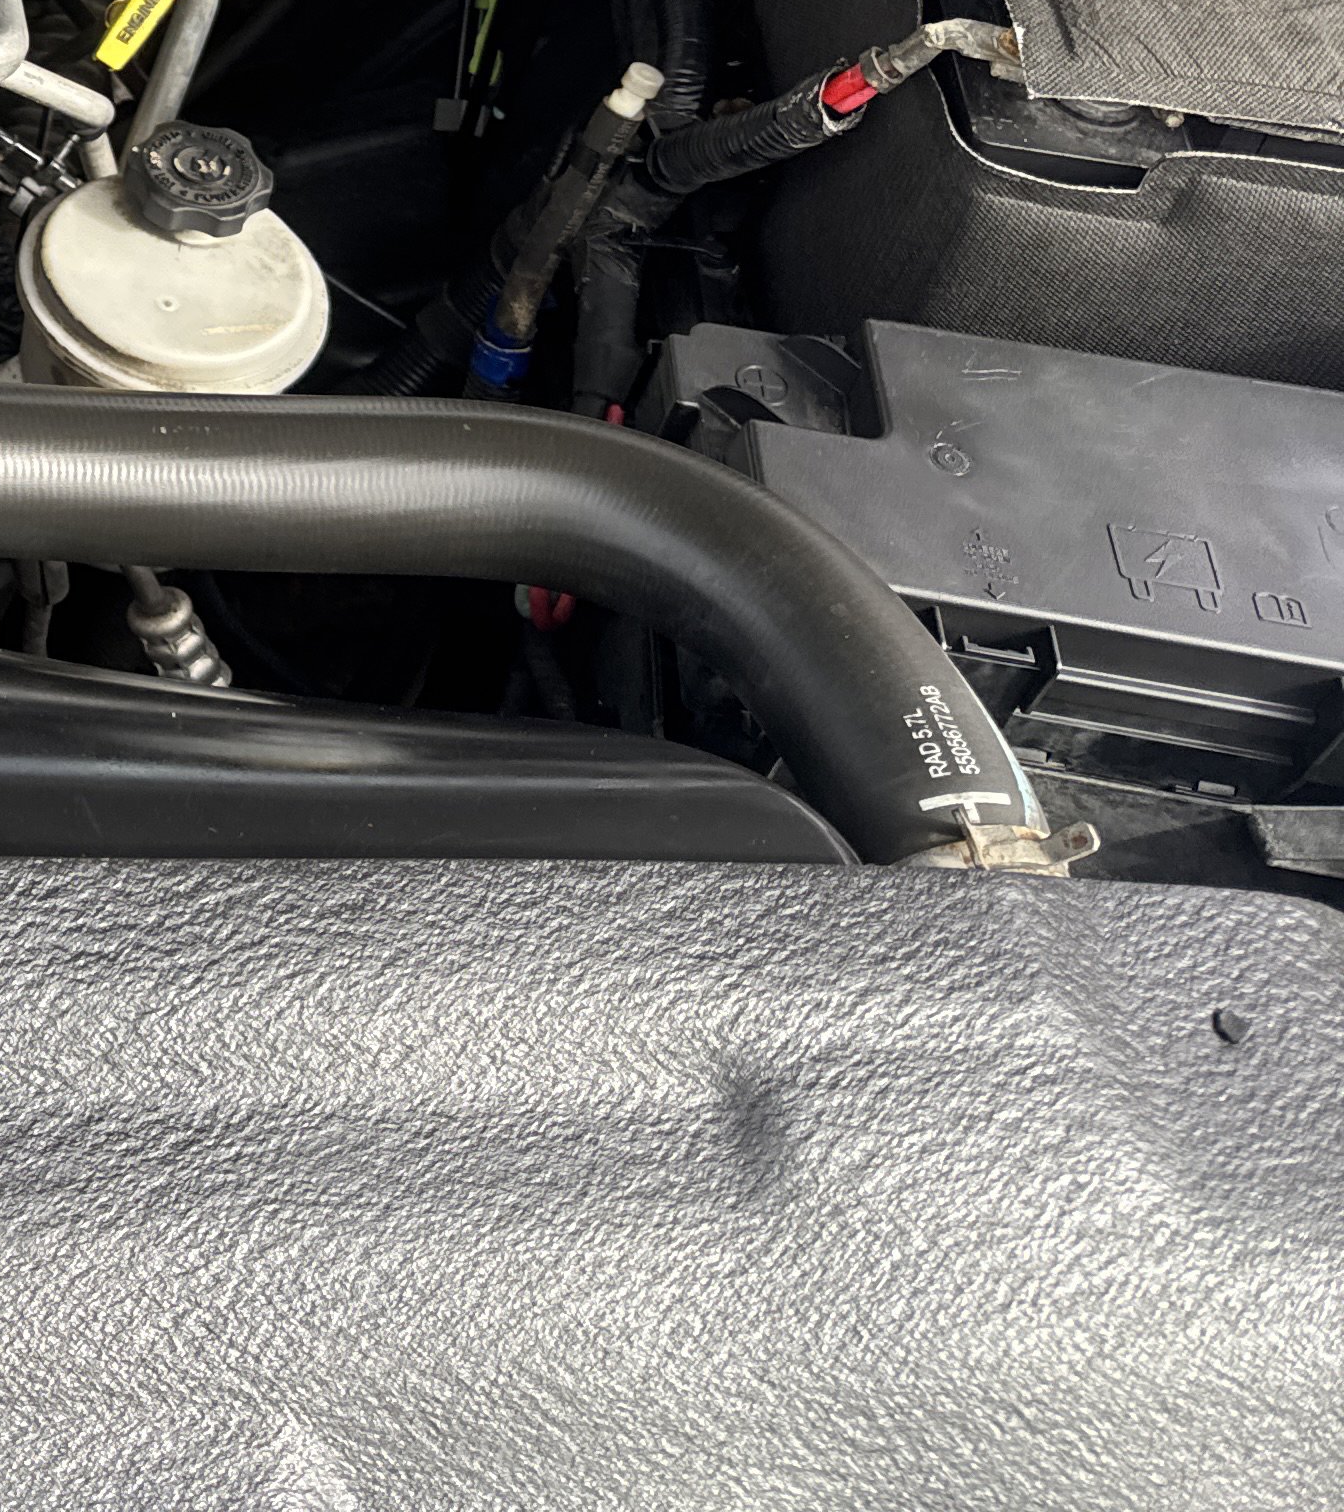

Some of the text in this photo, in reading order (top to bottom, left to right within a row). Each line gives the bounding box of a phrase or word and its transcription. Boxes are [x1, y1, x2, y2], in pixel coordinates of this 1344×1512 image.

[902, 707, 953, 779] RAD 5.7L
[919, 684, 982, 776] 55056772AB
